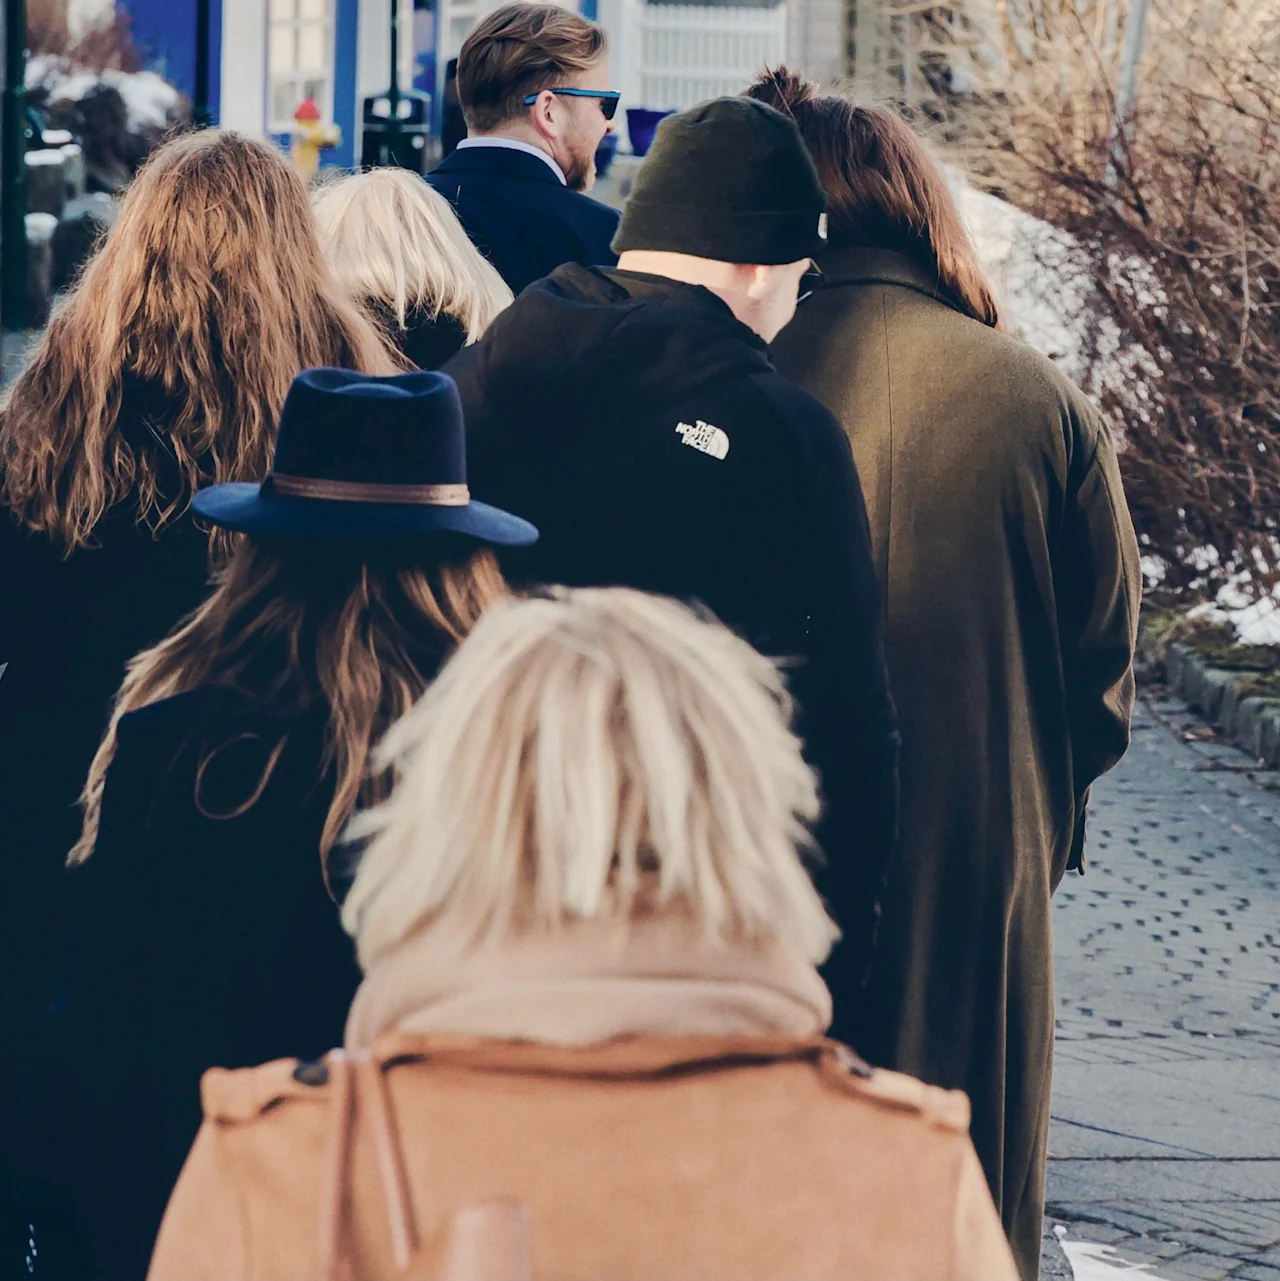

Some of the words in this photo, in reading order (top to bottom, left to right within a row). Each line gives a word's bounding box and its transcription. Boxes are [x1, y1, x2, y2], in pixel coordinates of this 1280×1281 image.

[675, 422, 712, 444] NORTH
[696, 420, 716, 435] THE
[682, 434, 709, 452] FACE
